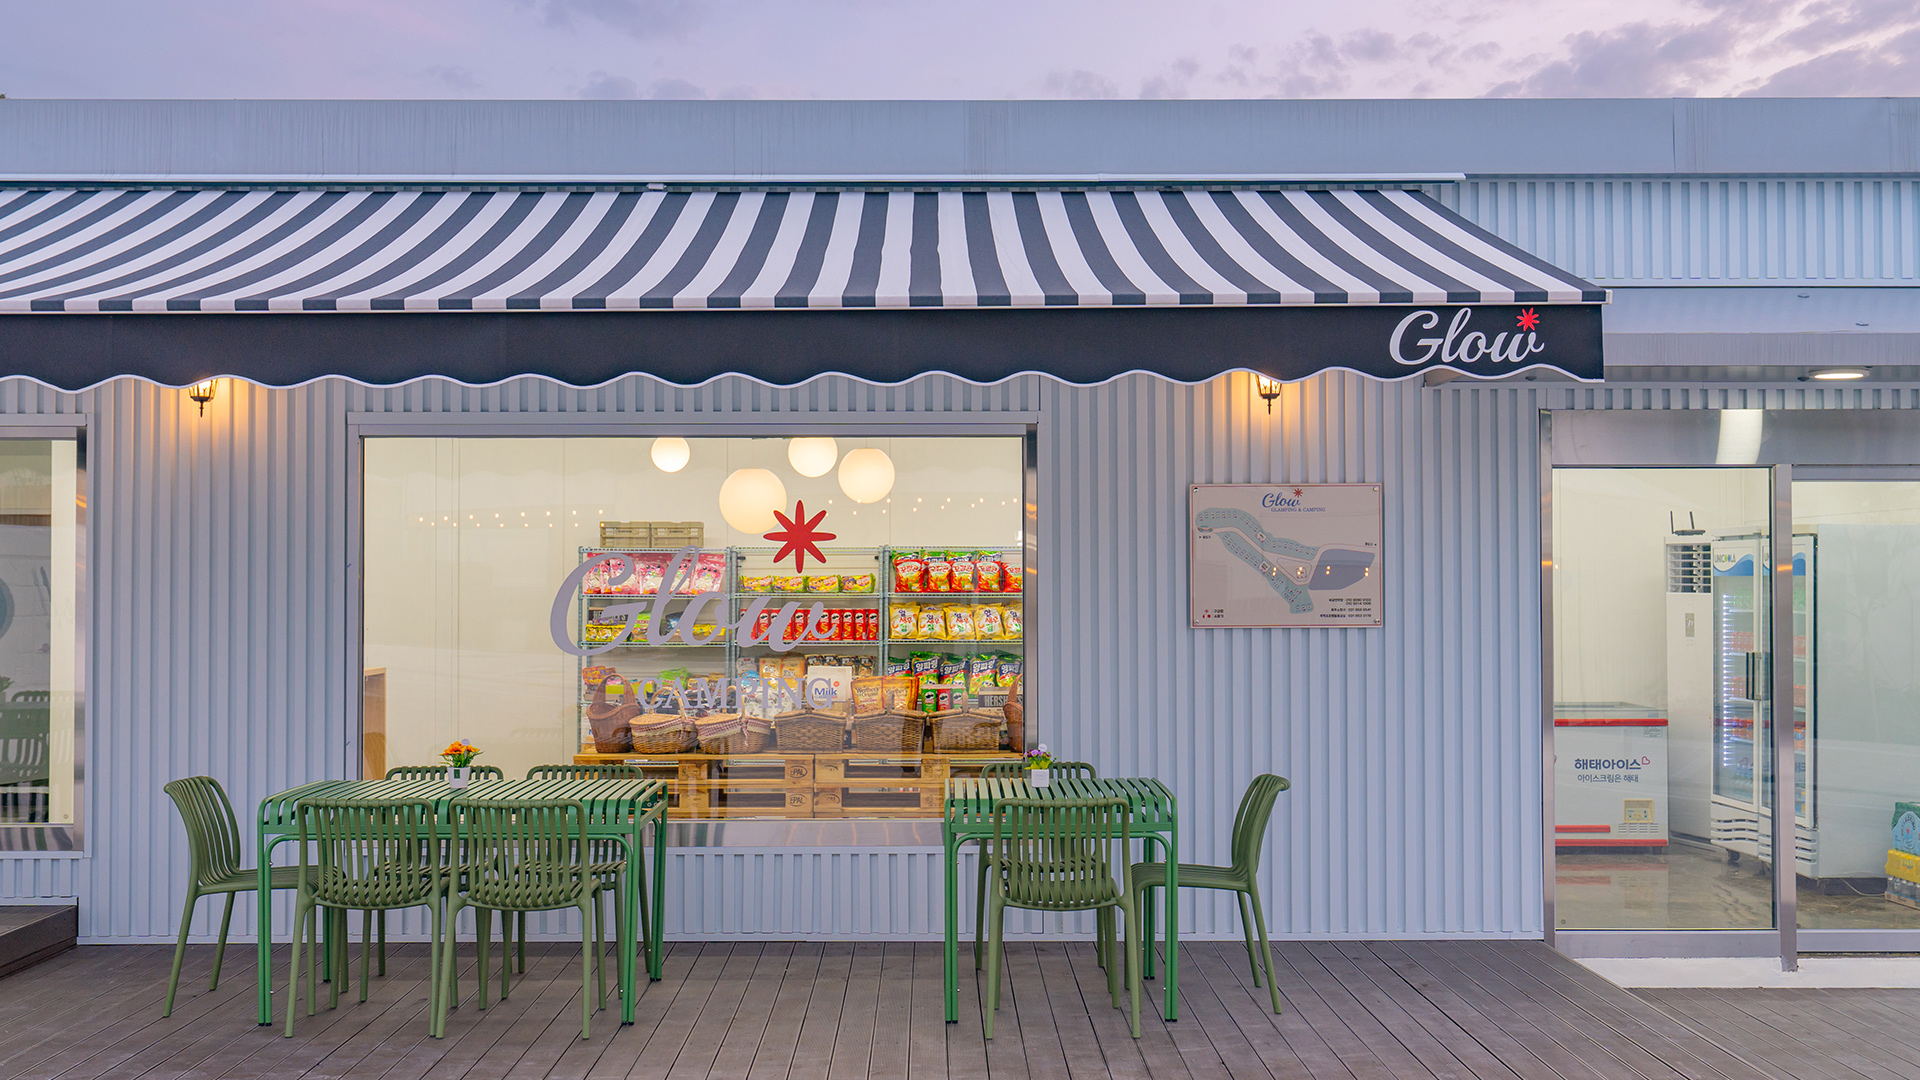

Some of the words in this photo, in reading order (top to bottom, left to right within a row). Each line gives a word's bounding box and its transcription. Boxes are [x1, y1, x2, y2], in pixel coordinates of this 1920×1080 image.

[1389, 307, 1545, 365] Glow
[1262, 492, 1301, 508] Glow
[550, 545, 837, 656] Glow
[637, 677, 832, 709] CAMPING
[814, 687, 838, 696] Milk
[1574, 758, 1641, 770] 해태아이스
[1577, 774, 1621, 783] 아이스크림은
[1623, 774, 1639, 783] 해태
